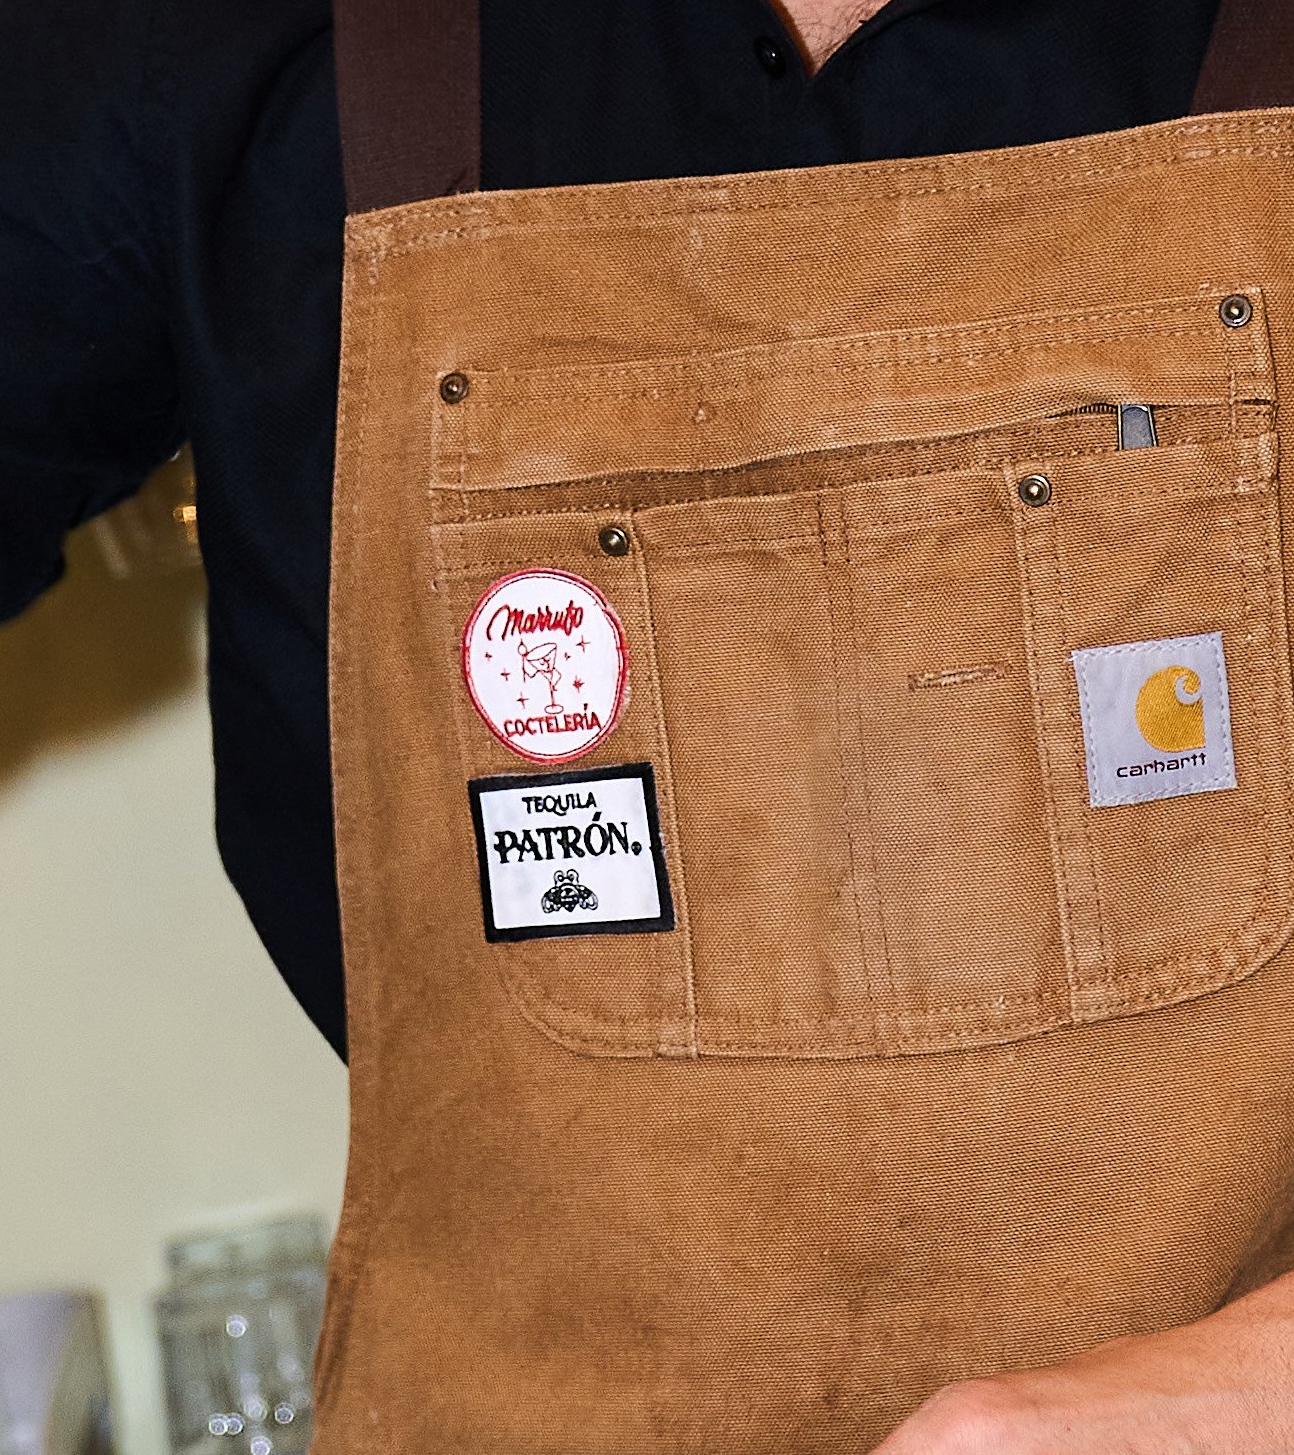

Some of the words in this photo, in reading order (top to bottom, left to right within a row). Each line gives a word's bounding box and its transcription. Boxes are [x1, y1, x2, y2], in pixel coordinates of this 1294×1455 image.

[504, 703, 602, 737] COCTELERÍA
[1116, 752, 1207, 778] carhartt
[521, 792, 597, 817] TEQUILA
